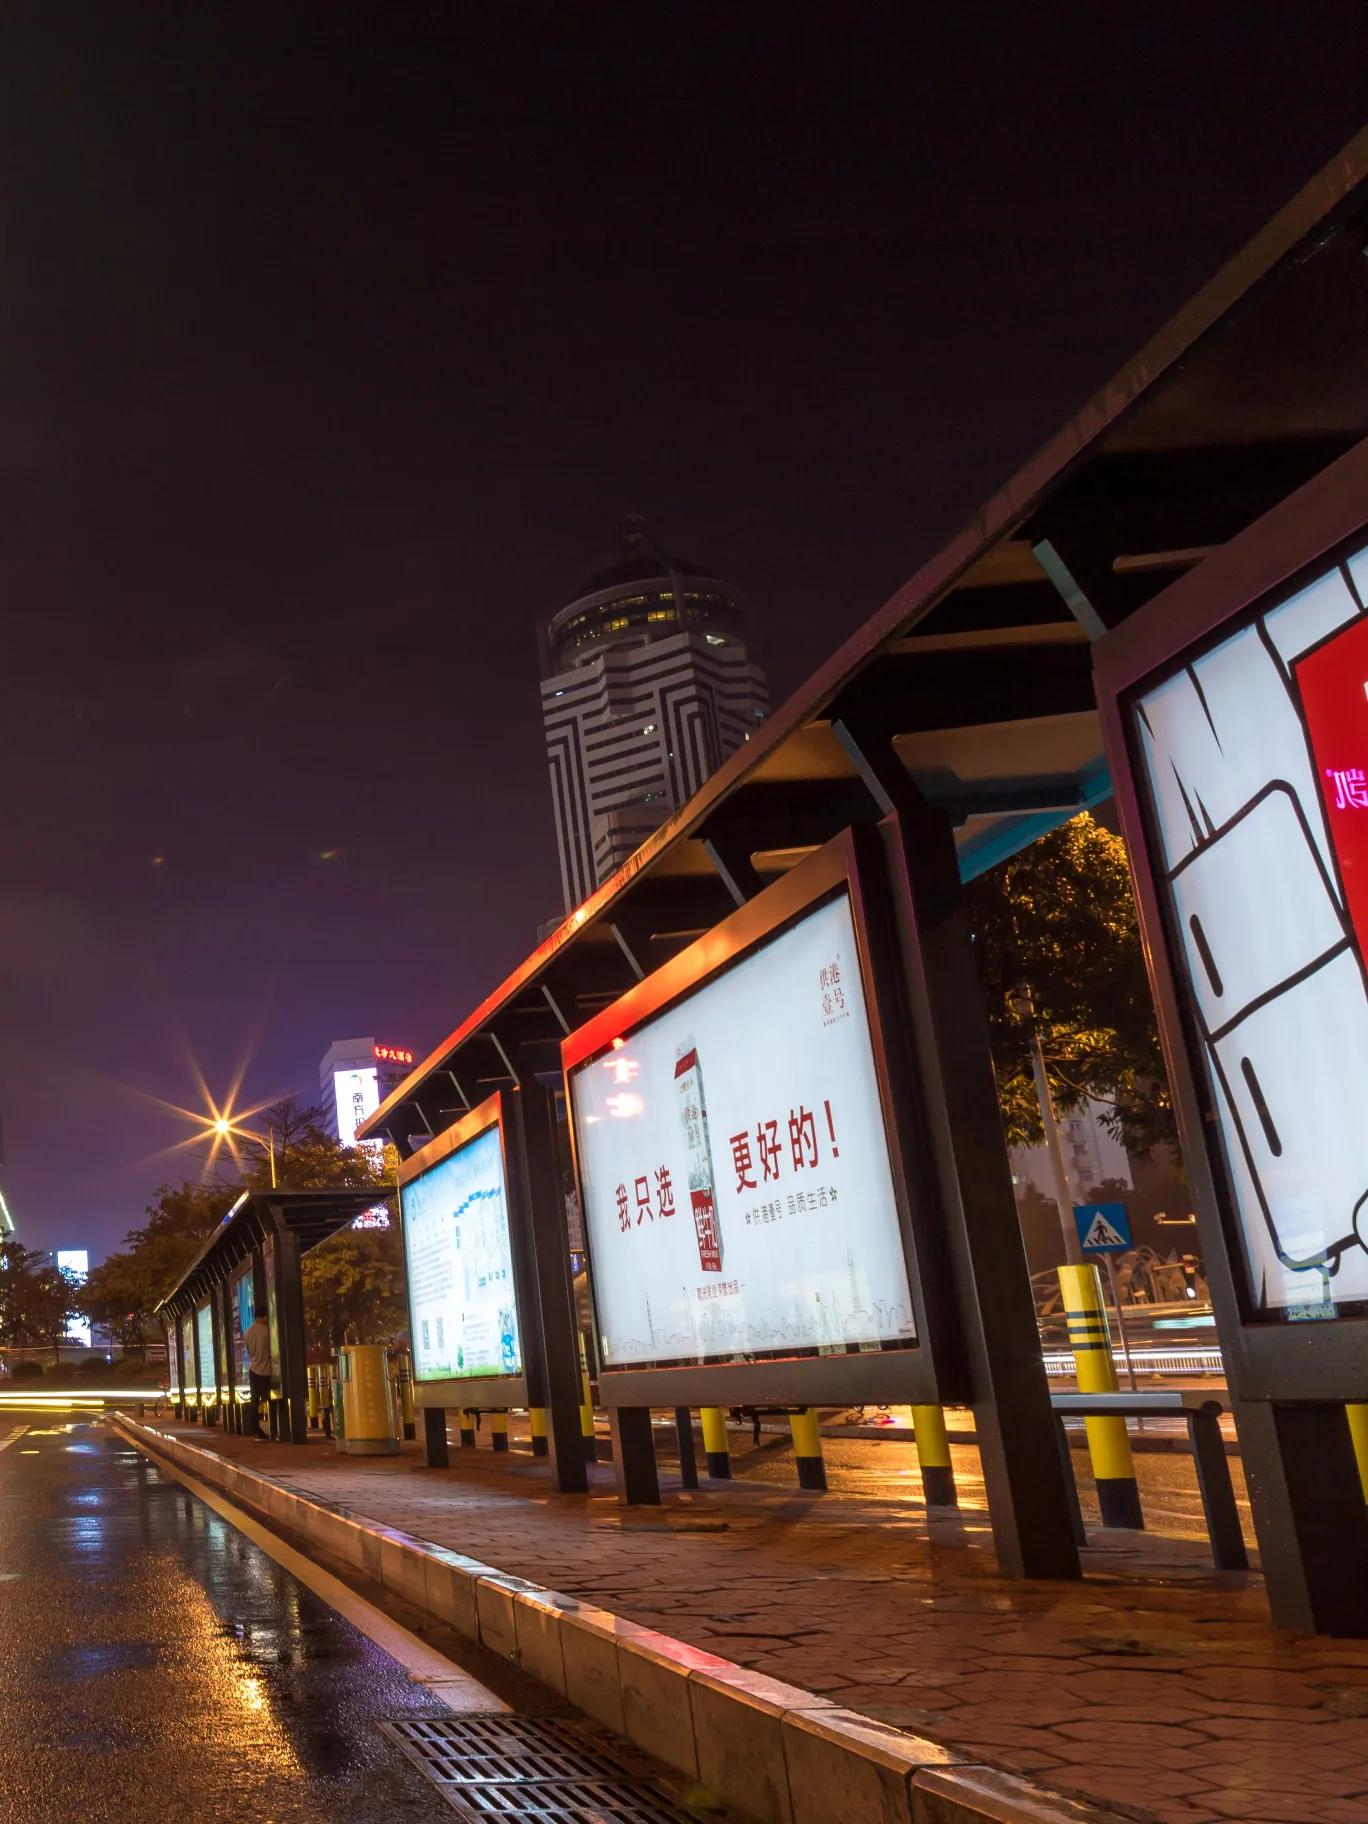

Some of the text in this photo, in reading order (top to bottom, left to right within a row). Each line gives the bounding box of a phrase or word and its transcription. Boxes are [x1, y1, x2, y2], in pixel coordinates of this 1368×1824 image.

[615, 1164, 676, 1233] 我只选
[786, 1186, 829, 1216] 品质生活
